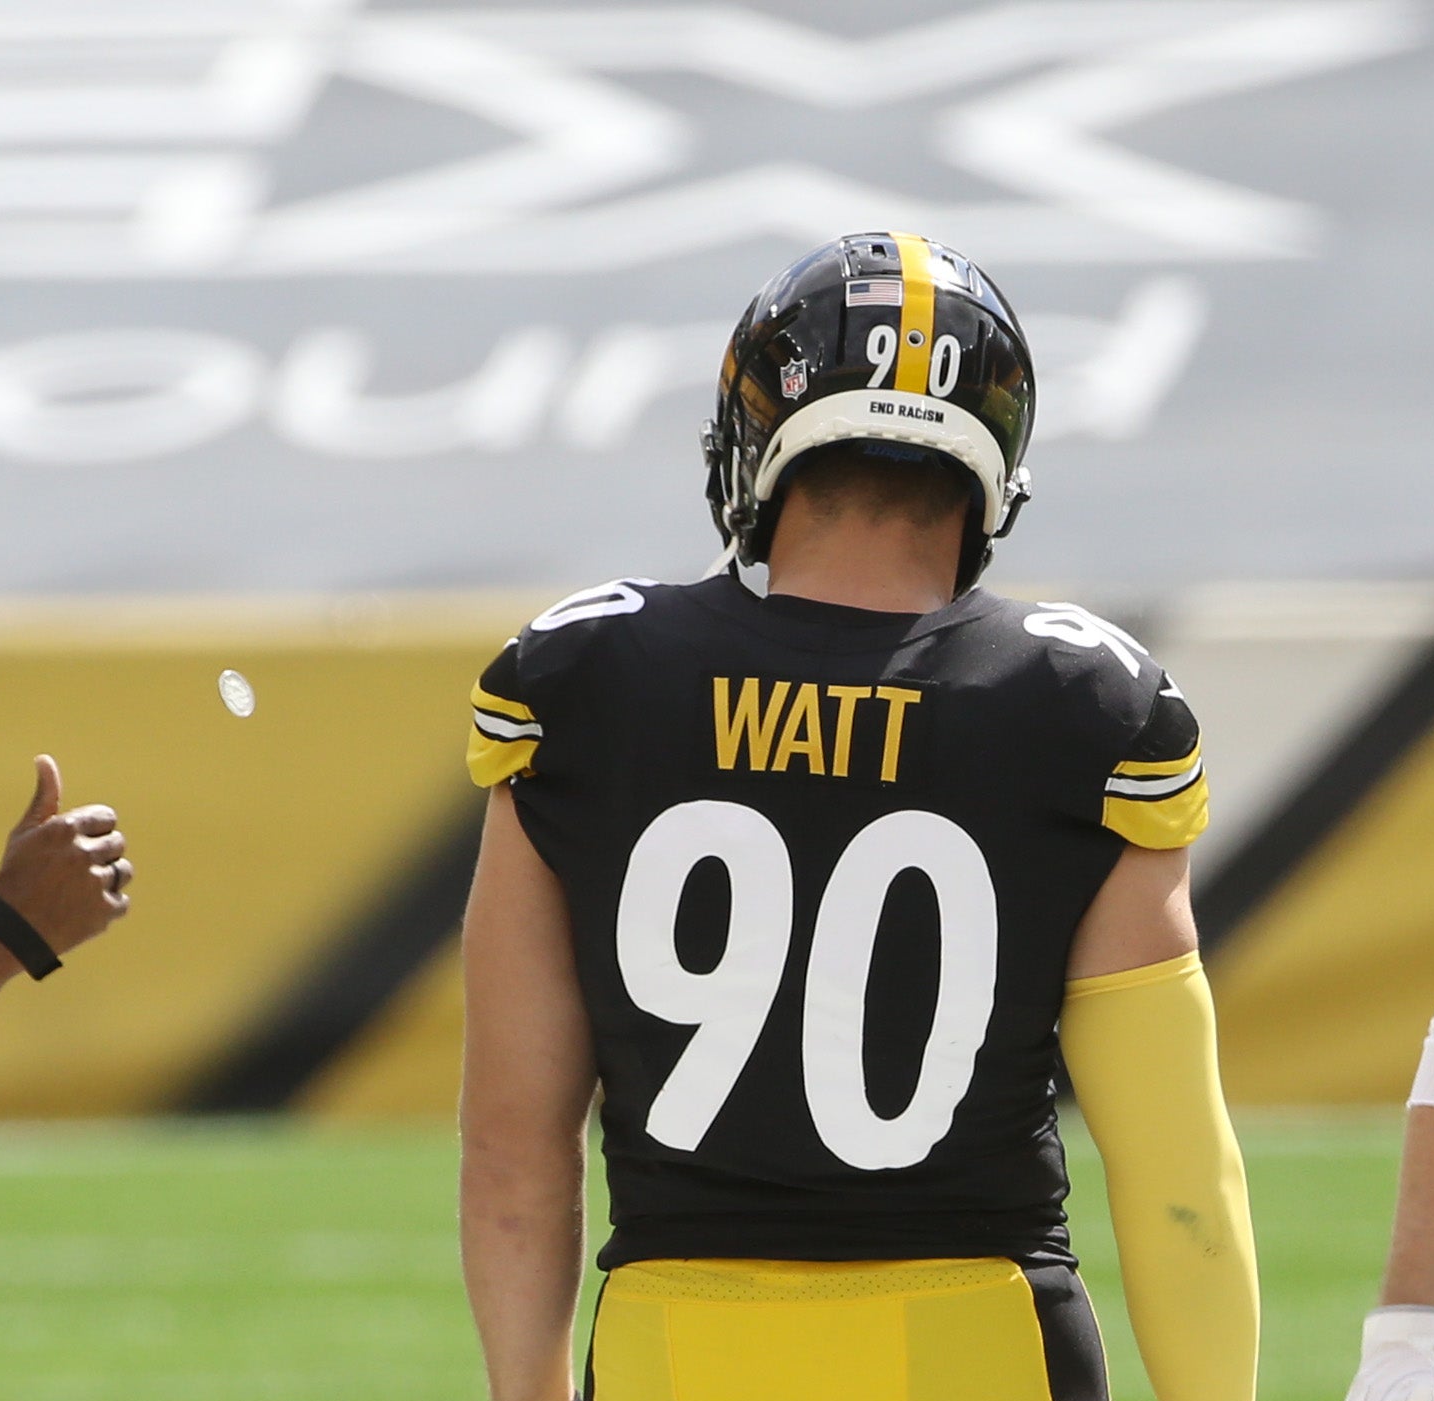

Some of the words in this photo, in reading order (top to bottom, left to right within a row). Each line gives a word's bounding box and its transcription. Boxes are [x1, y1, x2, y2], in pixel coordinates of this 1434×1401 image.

[866, 324, 961, 398] 90
[870, 401, 894, 415] END
[898, 404, 945, 424] RACISM
[530, 577, 660, 632] 0
[1022, 601, 1150, 679] 9
[711, 677, 923, 783] WATT
[616, 799, 999, 1171] 90
